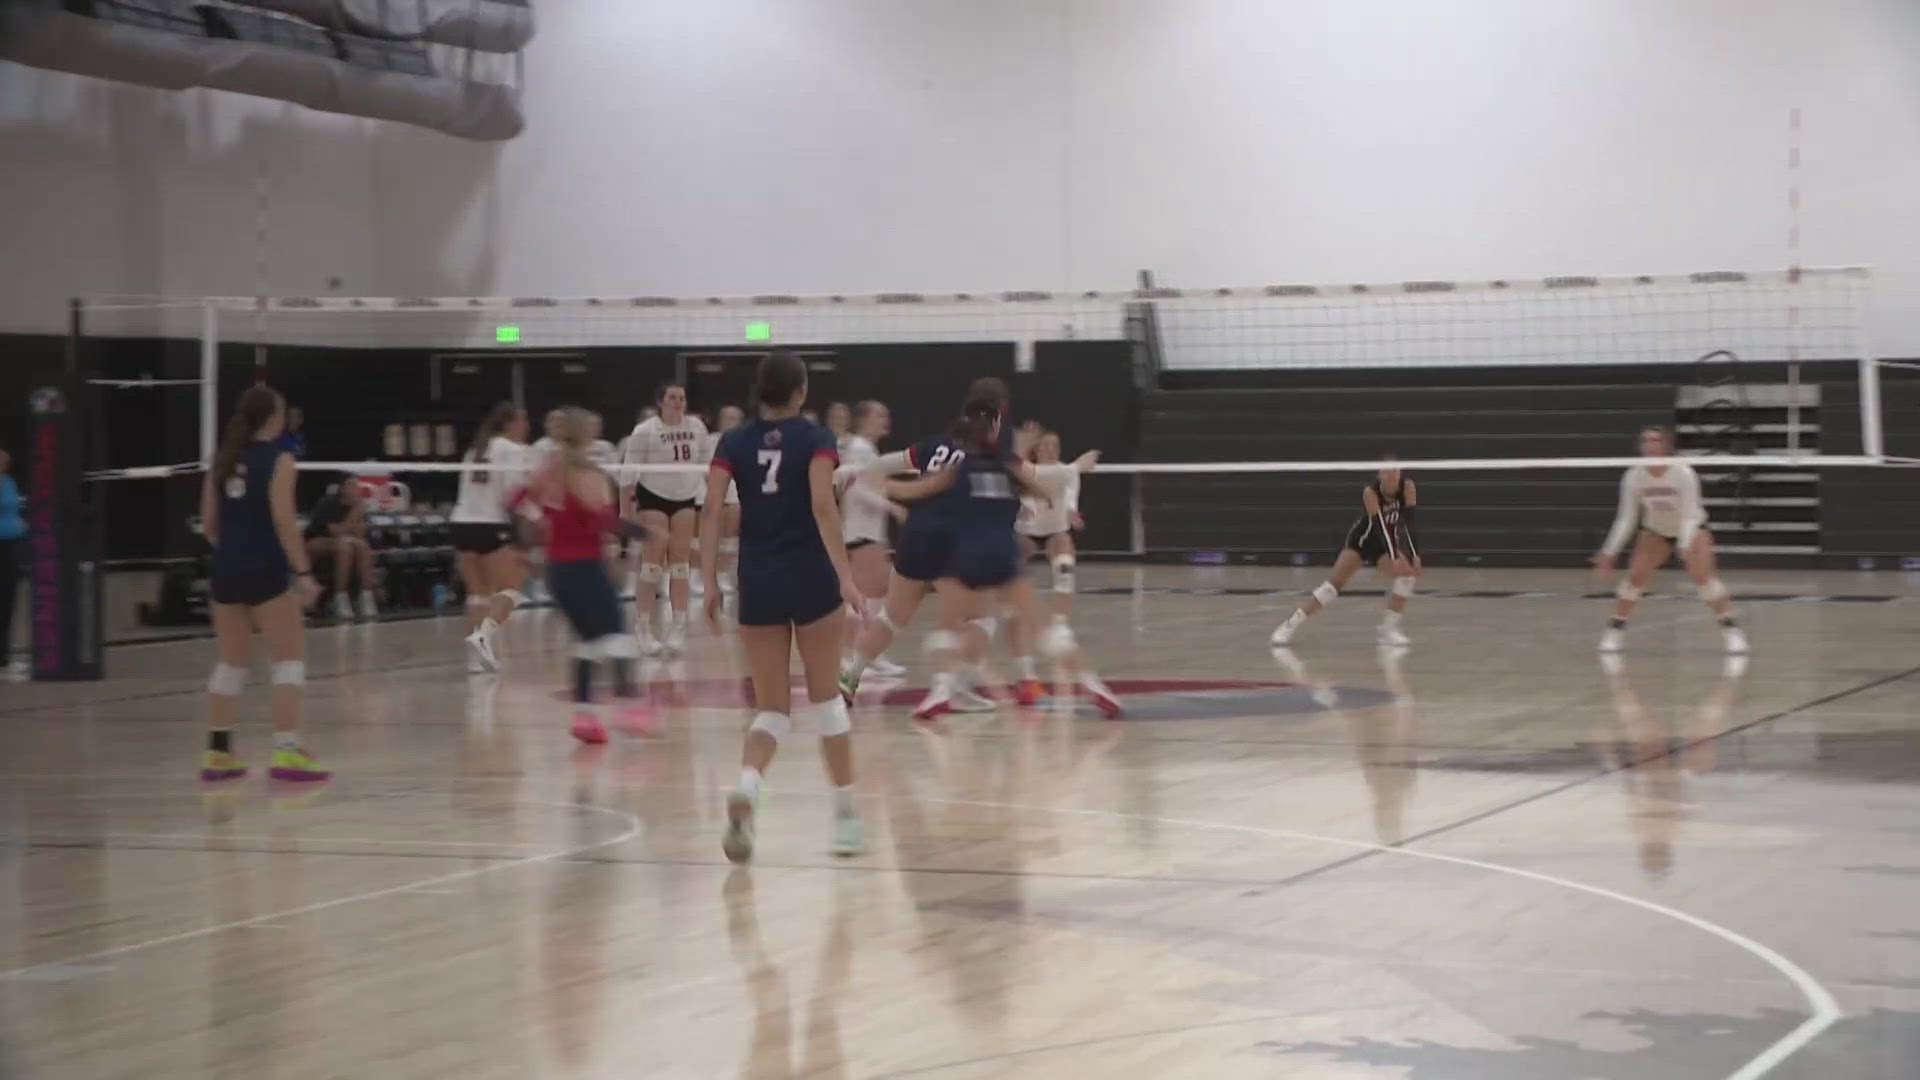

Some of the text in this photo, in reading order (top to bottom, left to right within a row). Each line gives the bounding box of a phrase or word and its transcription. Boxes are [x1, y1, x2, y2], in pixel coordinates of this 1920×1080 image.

[660, 432, 695, 444] SIERRA
[673, 443, 691, 461] 18
[757, 449, 782, 493] 7
